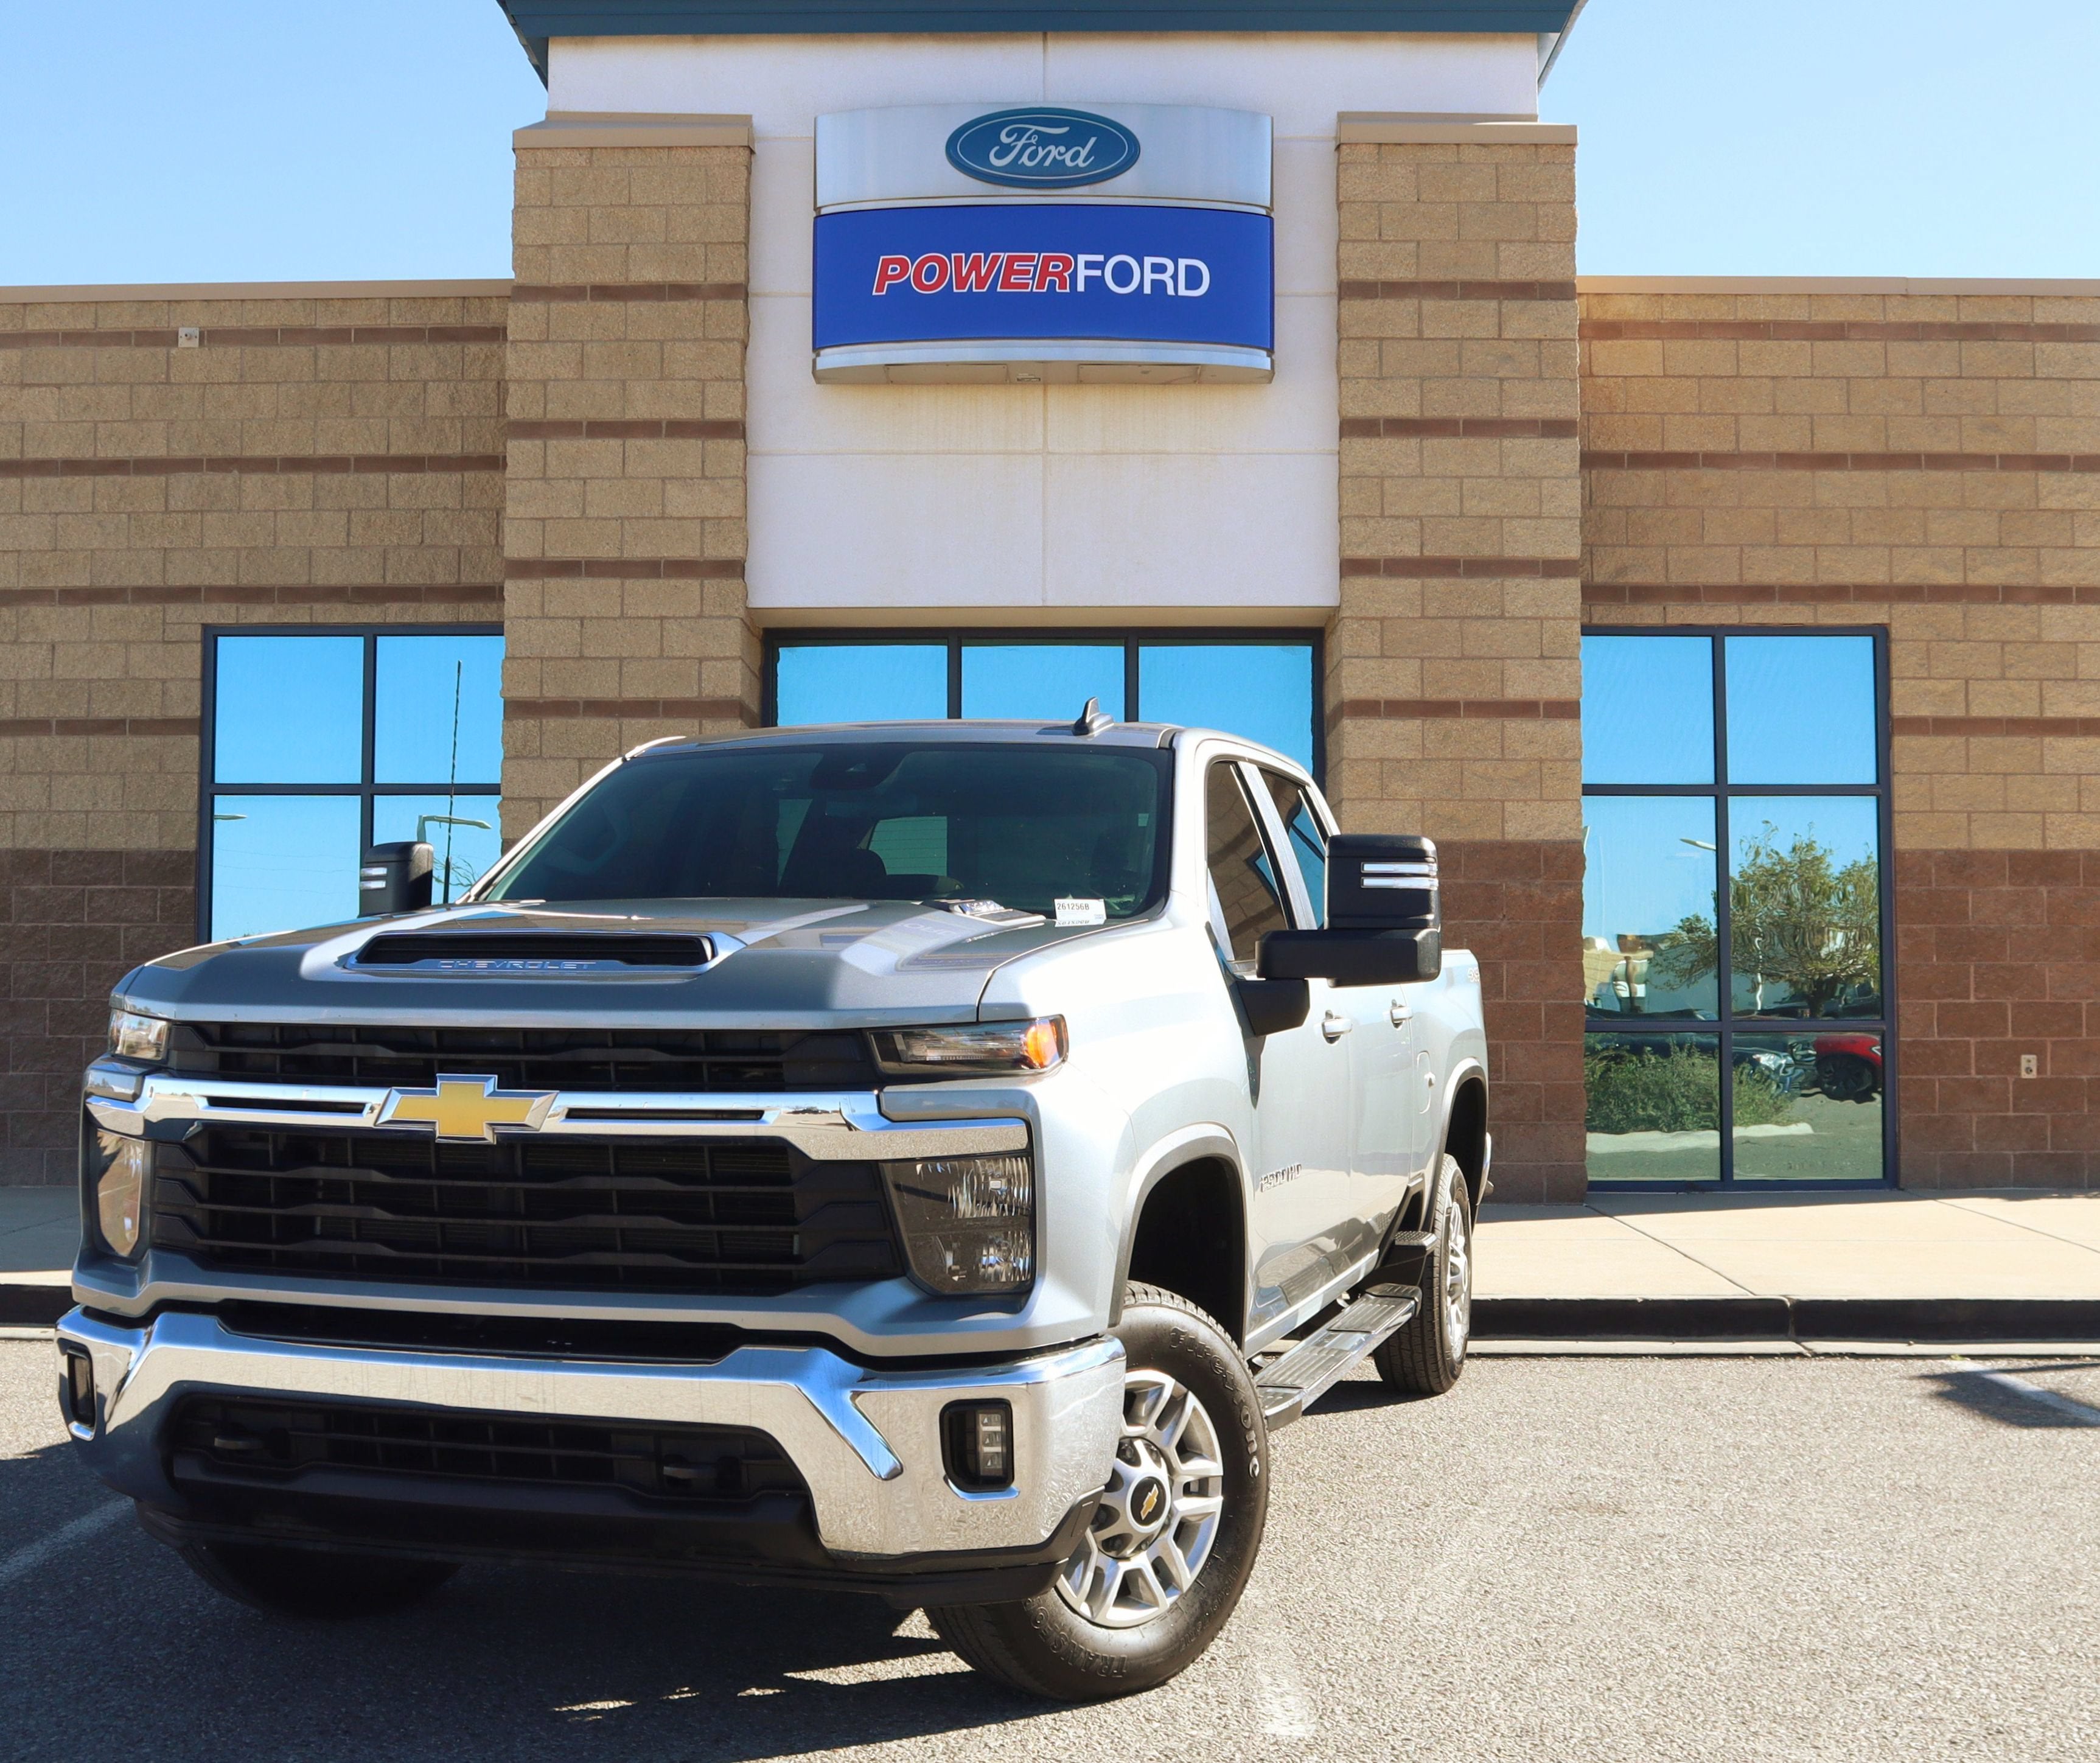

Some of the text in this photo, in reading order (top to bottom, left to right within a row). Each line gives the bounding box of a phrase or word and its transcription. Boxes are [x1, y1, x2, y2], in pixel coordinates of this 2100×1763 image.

[989, 124, 1098, 168] Ford
[871, 252, 1210, 297] POWERFORD
[438, 960, 596, 969] CHEVROLET
